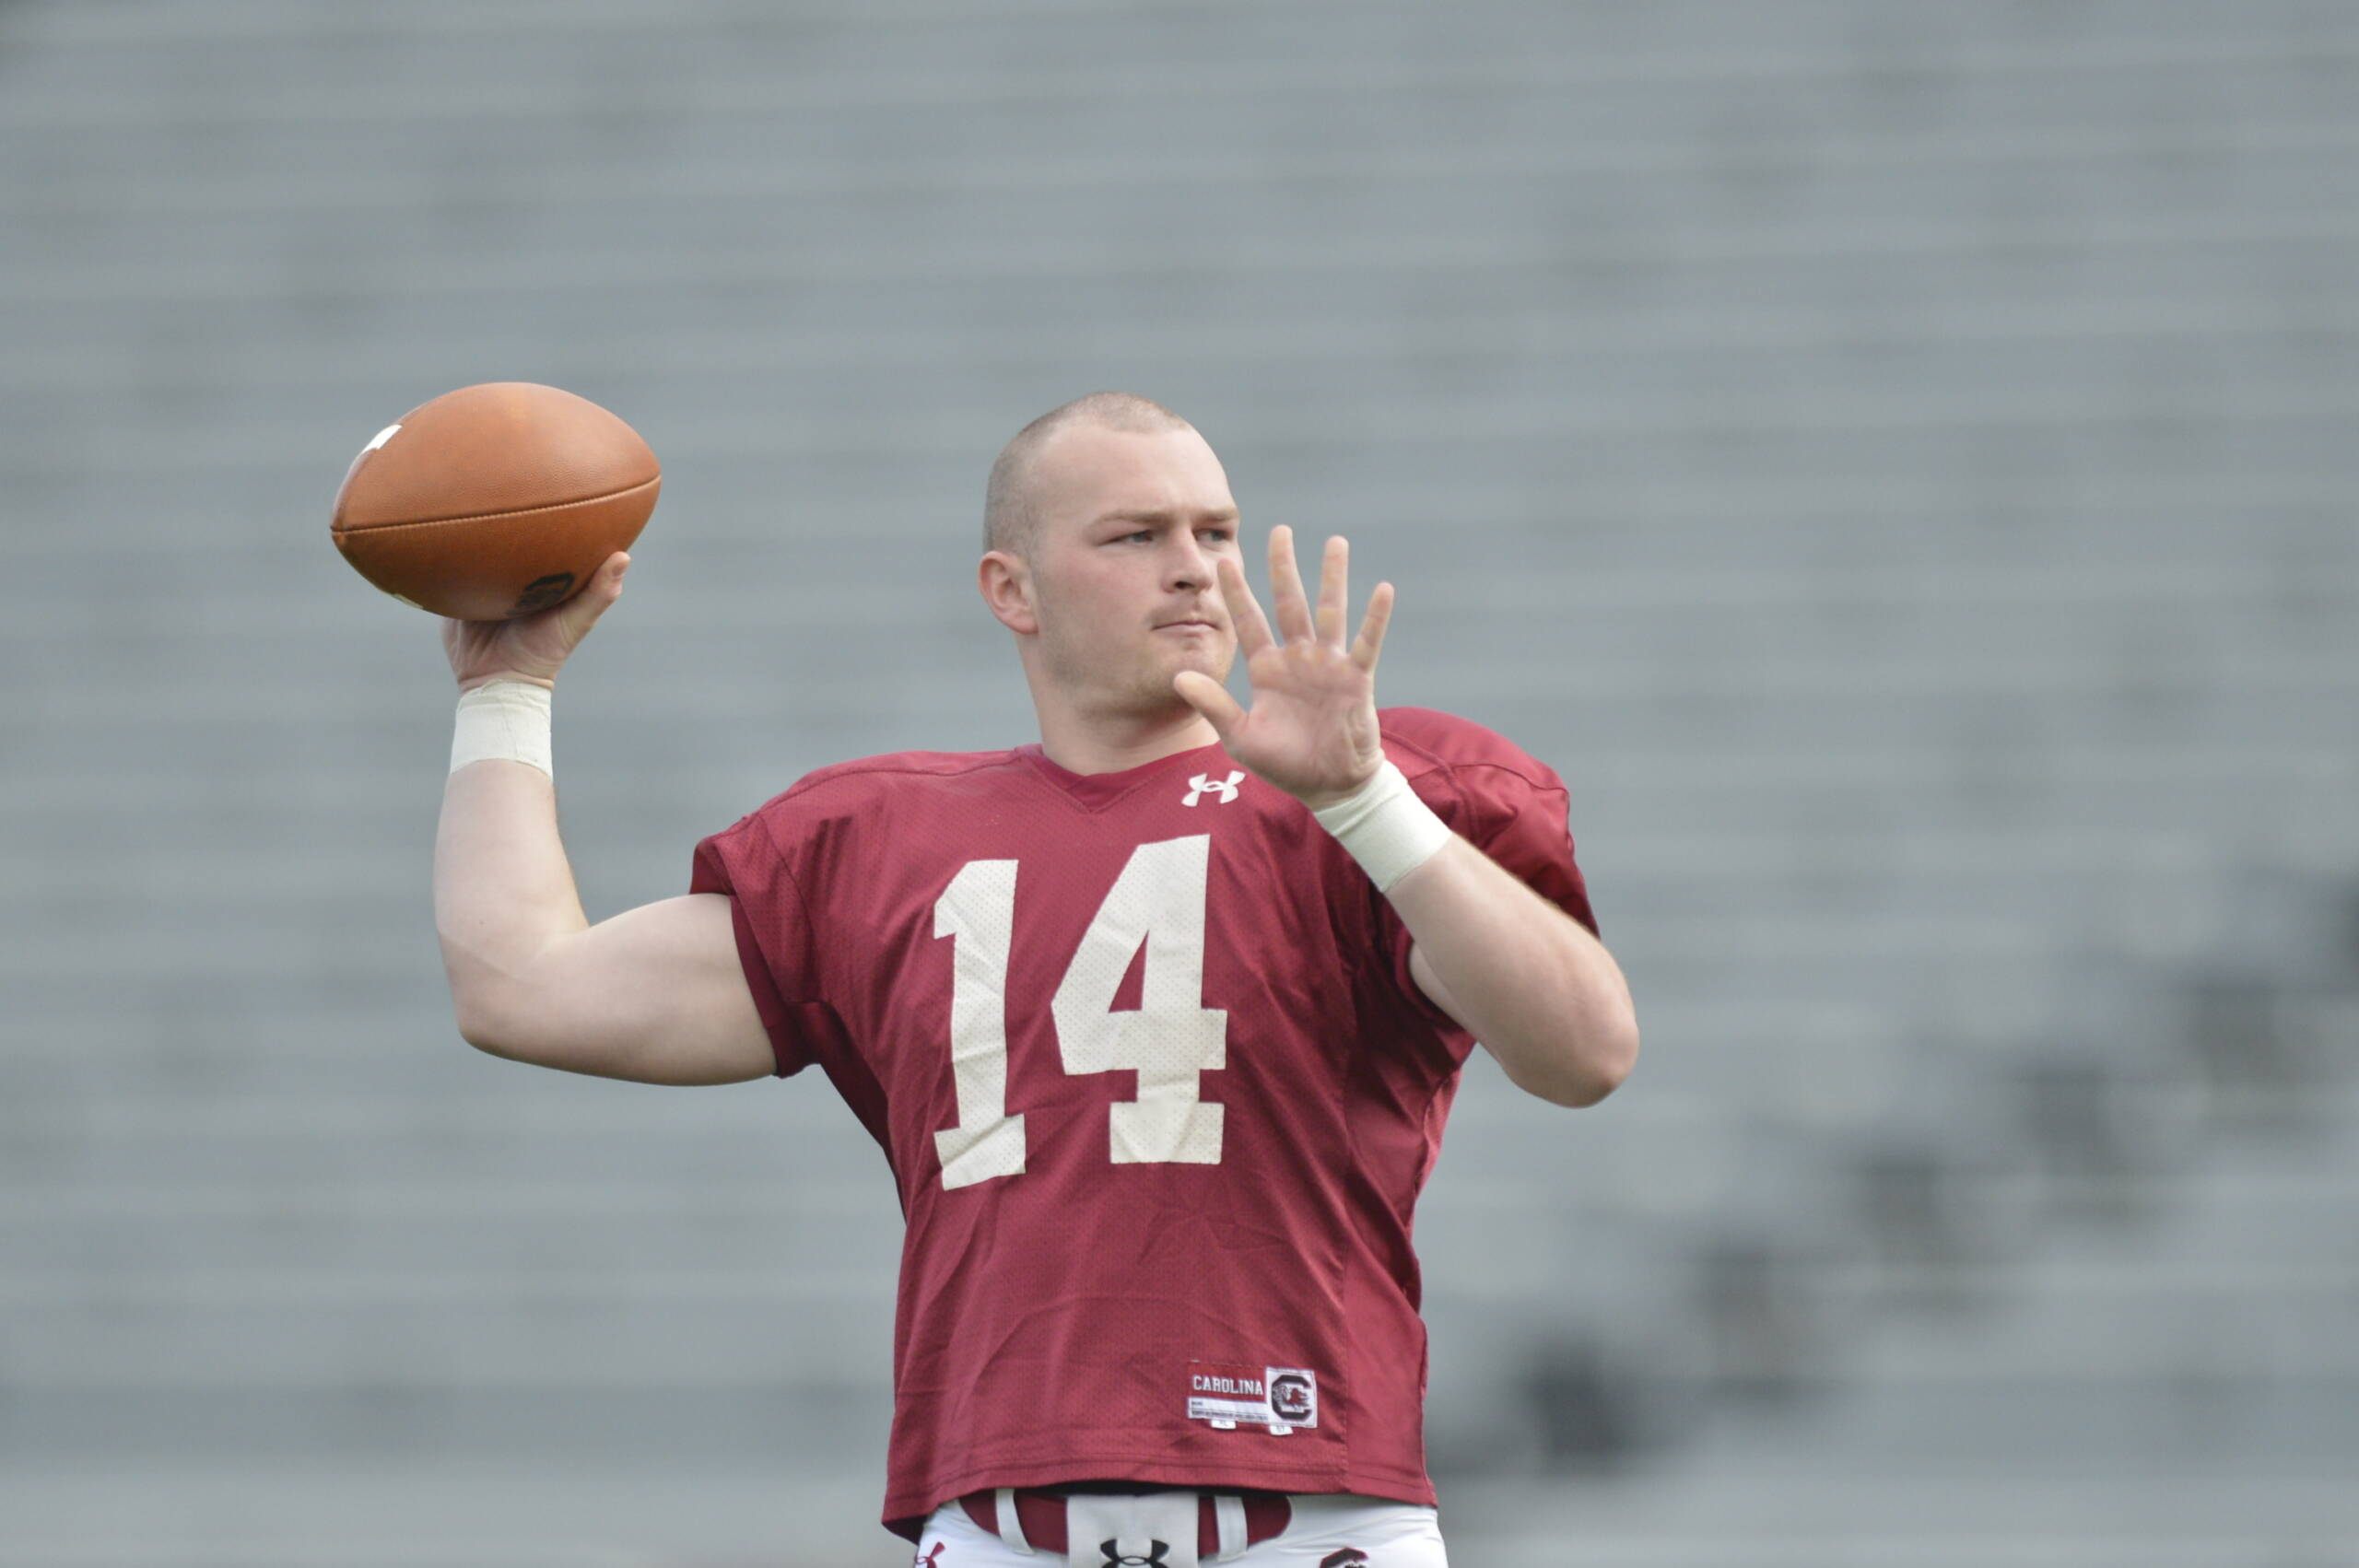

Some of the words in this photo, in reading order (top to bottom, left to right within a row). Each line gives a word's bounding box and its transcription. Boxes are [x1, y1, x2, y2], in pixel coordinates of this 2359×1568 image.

[933, 834, 1227, 1190] 14
[1193, 1375, 1263, 1396] CAROLINA
[1272, 1375, 1312, 1420] C
